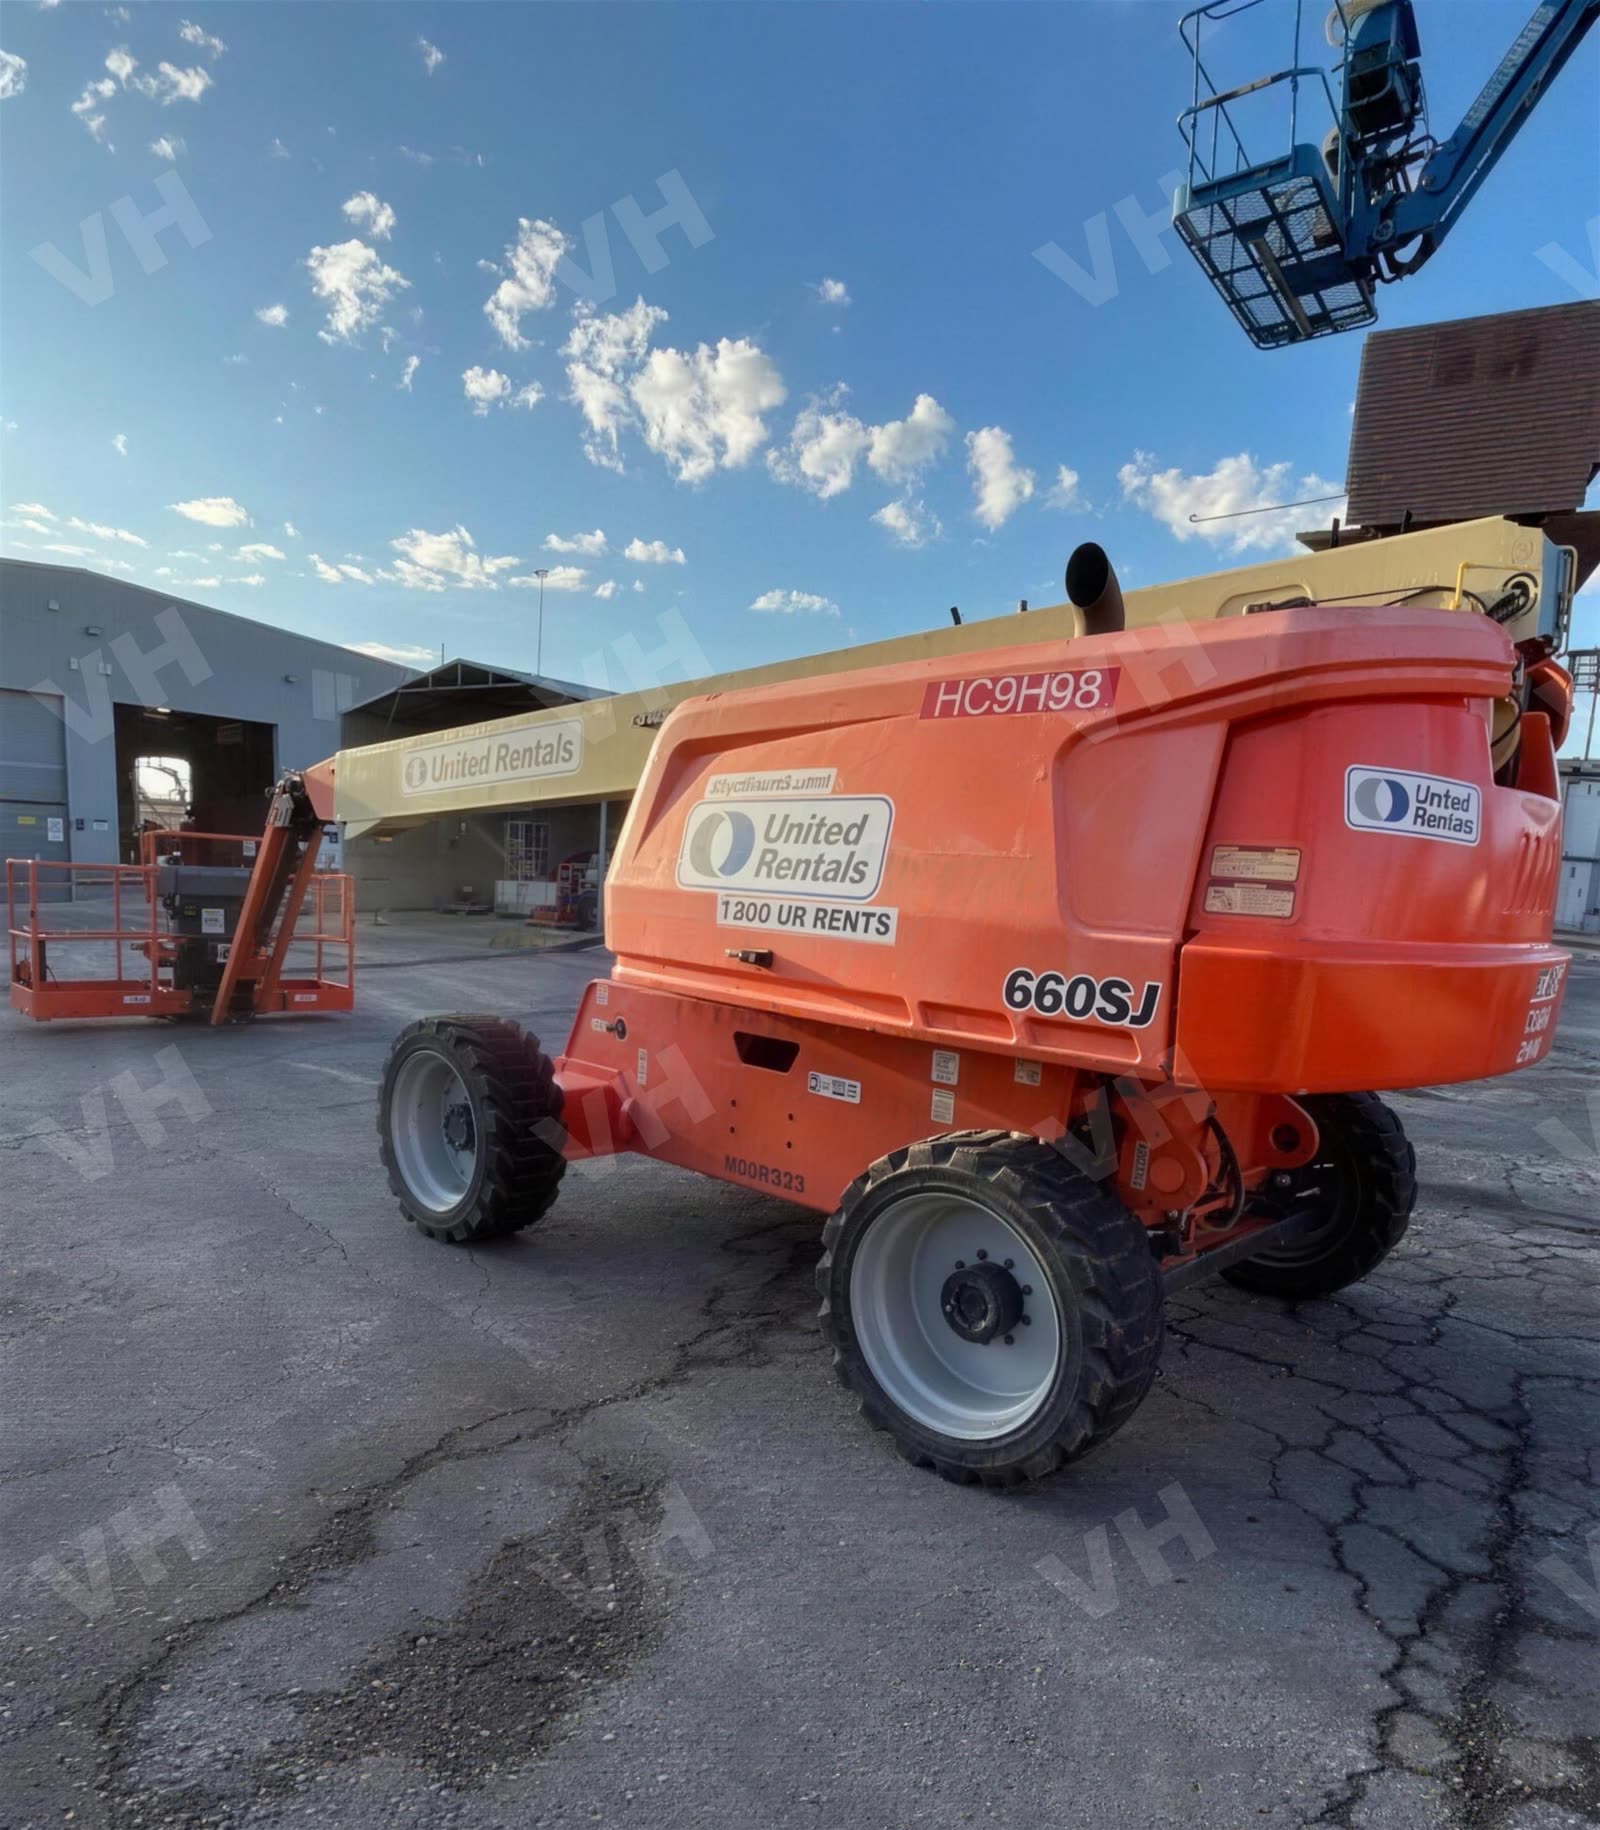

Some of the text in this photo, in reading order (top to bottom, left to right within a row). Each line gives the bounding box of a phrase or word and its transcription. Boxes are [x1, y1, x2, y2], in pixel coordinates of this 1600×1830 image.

[933, 670, 1103, 718] HC9H98
[430, 733, 574, 783] United Rentals
[763, 813, 870, 846] United
[753, 848, 869, 885] Rentals
[777, 904, 807, 928] UR
[812, 907, 891, 936] RENTS
[1003, 968, 1162, 1028] 660SJ
